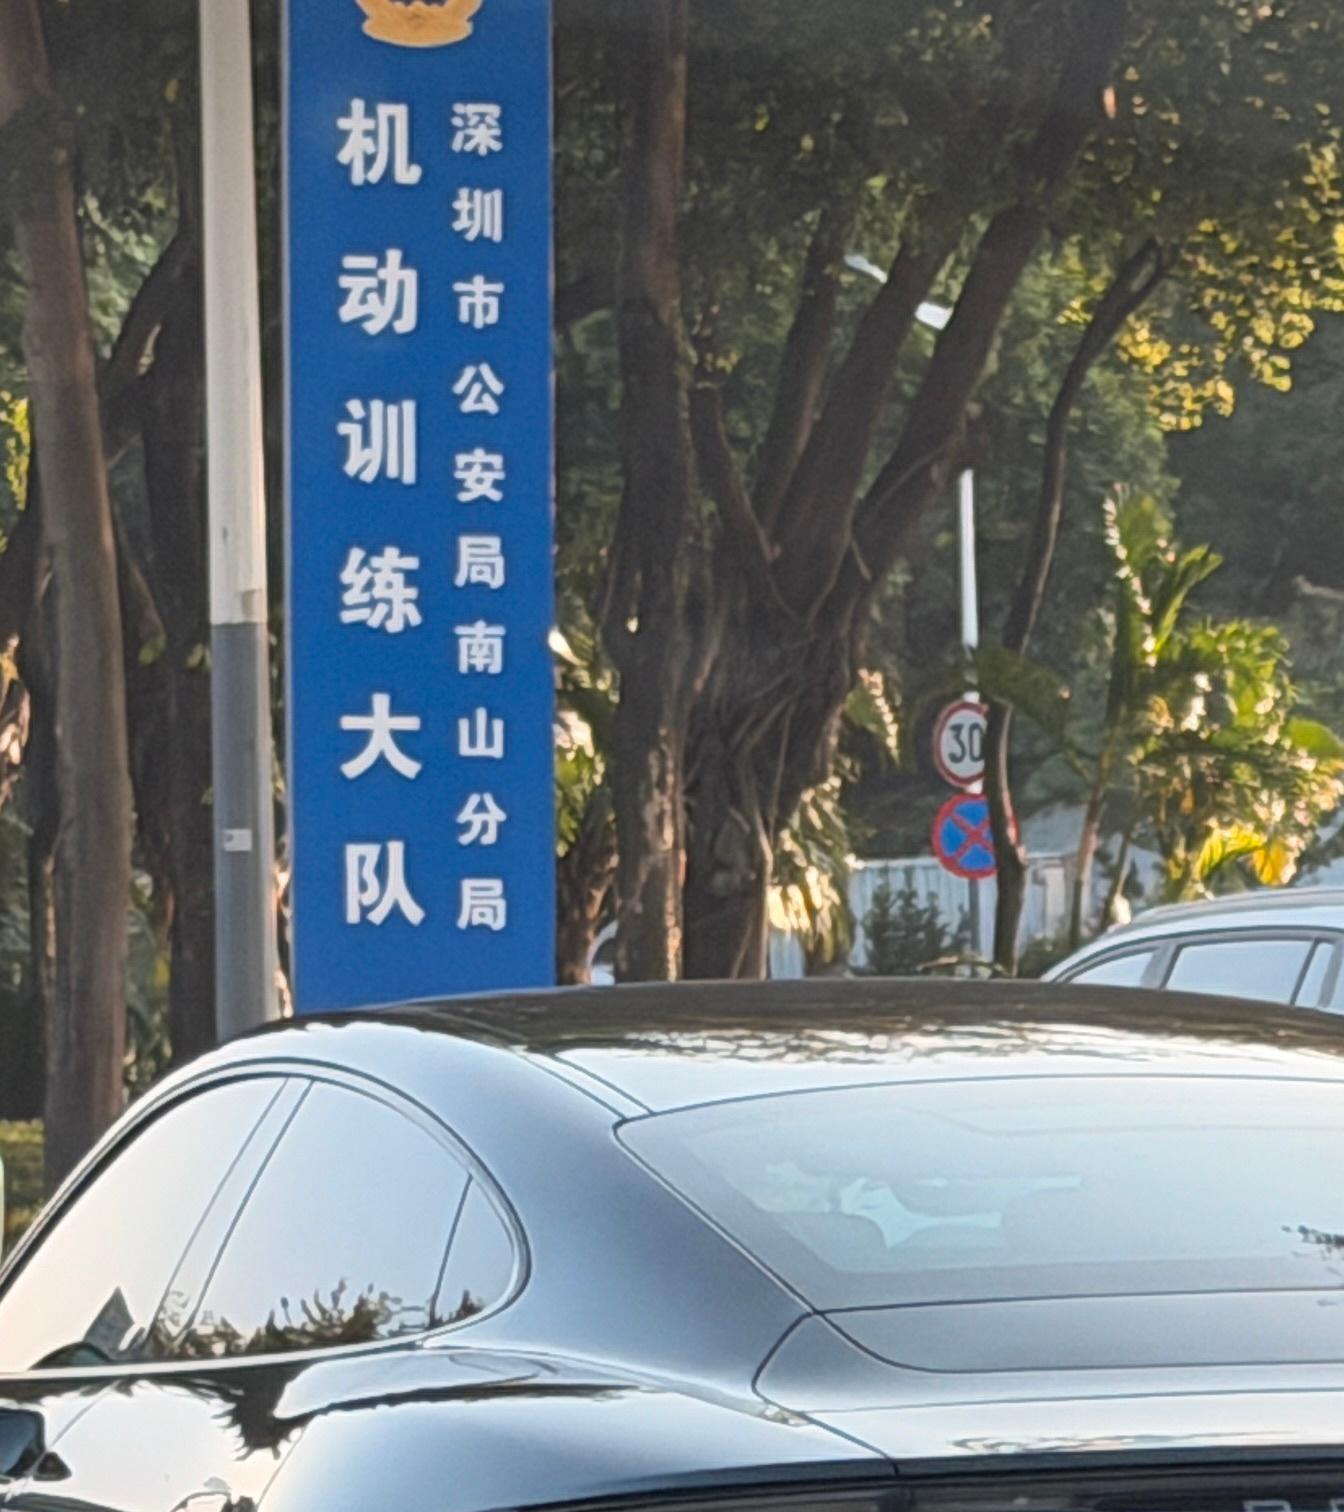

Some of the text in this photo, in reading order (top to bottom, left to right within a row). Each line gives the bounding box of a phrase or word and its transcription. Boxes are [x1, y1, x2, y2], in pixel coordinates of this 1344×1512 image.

[336, 98, 425, 925] 机动训练大队
[451, 103, 507, 931] 深圳市公安局南山分局
[949, 722, 985, 765] 30
